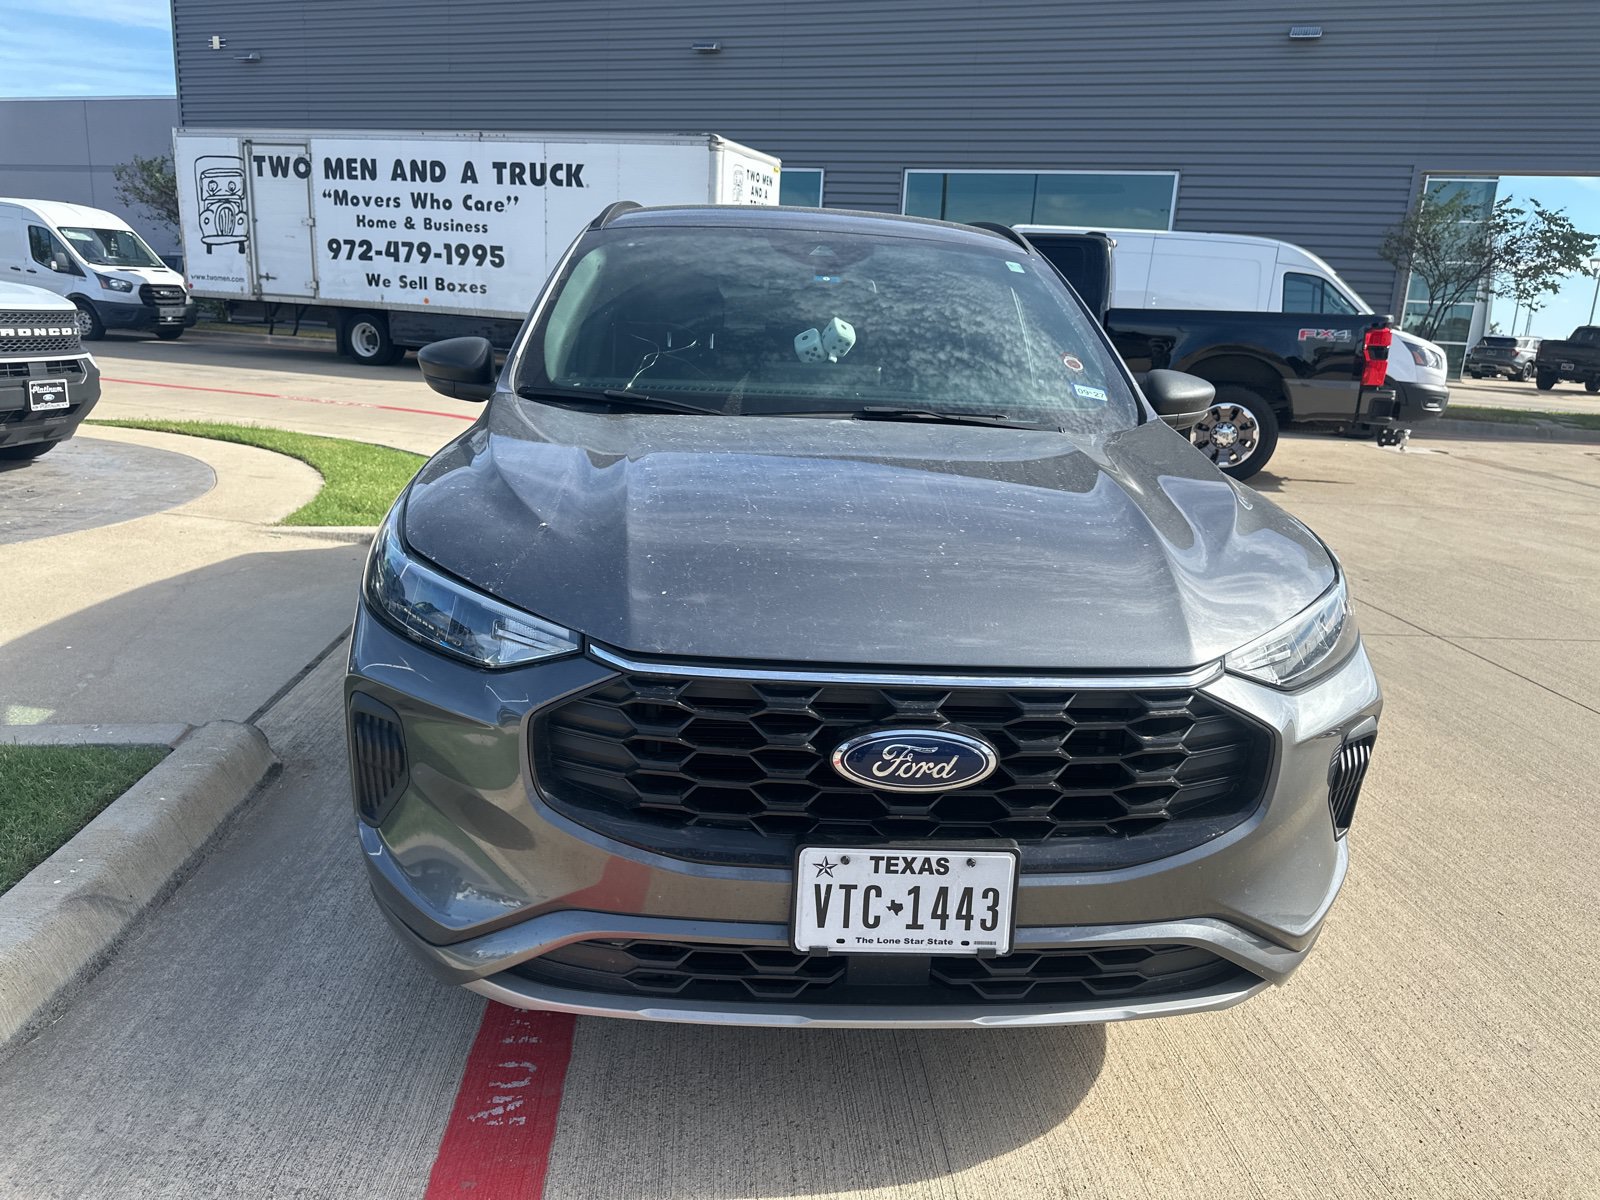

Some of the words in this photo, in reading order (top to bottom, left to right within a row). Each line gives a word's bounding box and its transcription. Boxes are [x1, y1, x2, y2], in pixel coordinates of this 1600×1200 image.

[253, 155, 312, 179] TWO
[323, 157, 378, 181] MEN
[390, 159, 447, 183] AND
[460, 161, 479, 184] A
[492, 161, 585, 188] TRUCK
[746, 169, 760, 183] TWO
[762, 174, 773, 187] MEN
[410, 192, 453, 211] Who
[751, 186, 762, 198] AND
[356, 214, 397, 229] Home
[404, 217, 416, 230] &
[423, 218, 489, 234] Business
[328, 239, 505, 268] 972-479-1995
[190, 273, 245, 283] www.twomen.com
[366, 273, 392, 288] We
[399, 275, 428, 291] Sell
[435, 277, 488, 295] Boxes
[1297, 327, 1352, 343] FX4
[872, 743, 960, 779] Ford
[869, 855, 950, 876] TEXAS
[814, 883, 883, 930] VTC
[905, 885, 1000, 932] 1443
[855, 936, 875, 945] The
[876, 936, 901, 945] Lone
[903, 937, 925, 946] Star
[926, 937, 954, 947] State
